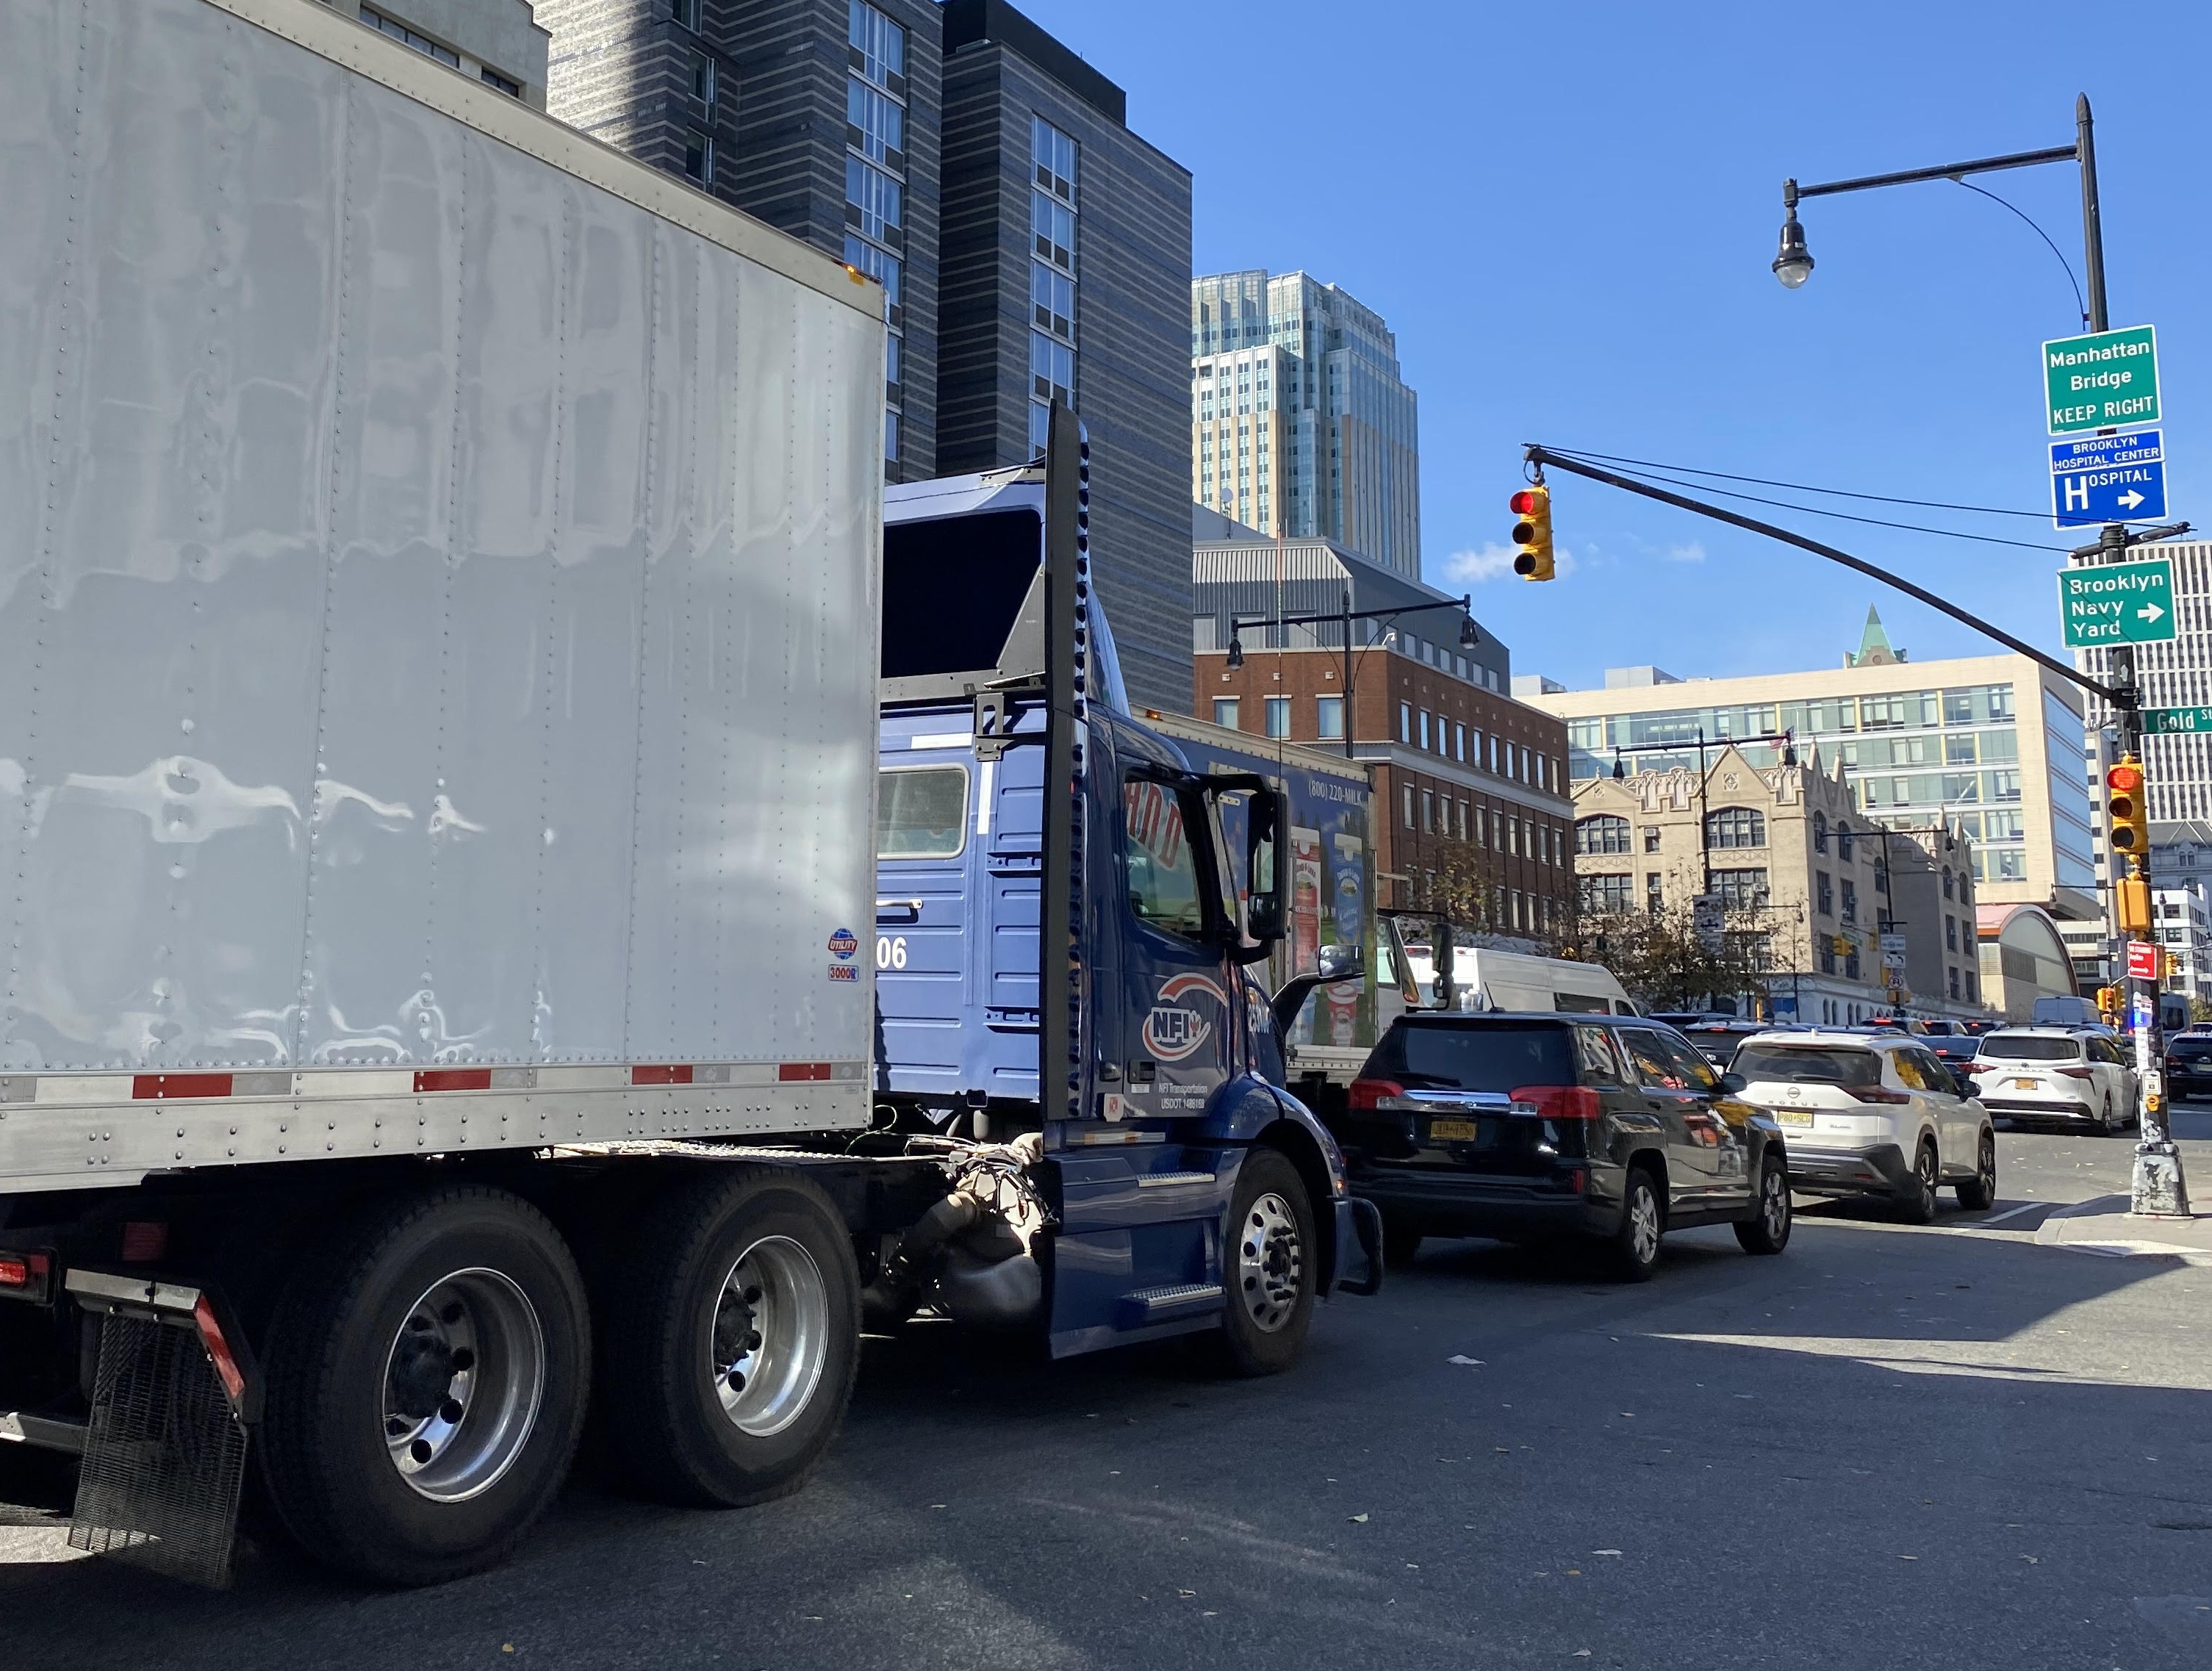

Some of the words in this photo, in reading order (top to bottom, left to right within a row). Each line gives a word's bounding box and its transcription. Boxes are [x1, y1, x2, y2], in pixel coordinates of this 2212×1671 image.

[2050, 342, 2150, 367] Manhattan
[2070, 370, 2132, 391] Bridge
[2053, 404, 2097, 424] KEEP
[2104, 395, 2153, 417] RIGHT
[2072, 436, 2137, 454] BROOKLYN
[2053, 454, 2109, 470] HOSPITAL
[2114, 447, 2159, 462] CENTER
[2069, 573, 2163, 594] Brooklyn
[2071, 600, 2124, 617] Navy
[2072, 619, 2122, 638] Yard
[2156, 711, 2194, 732] Gold
[2201, 709, 2212, 720] St
[1308, 779, 1328, 801] (800)
[1329, 783, 1362, 806] 220-MILK
[829, 939, 857, 950] UTILITY
[877, 936, 907, 969] 06
[830, 966, 856, 980] 3000R
[1152, 1010, 1190, 1040] NFI
[1168, 1082, 1207, 1096] Transportation
[1160, 1098, 1182, 1110] USDOT
